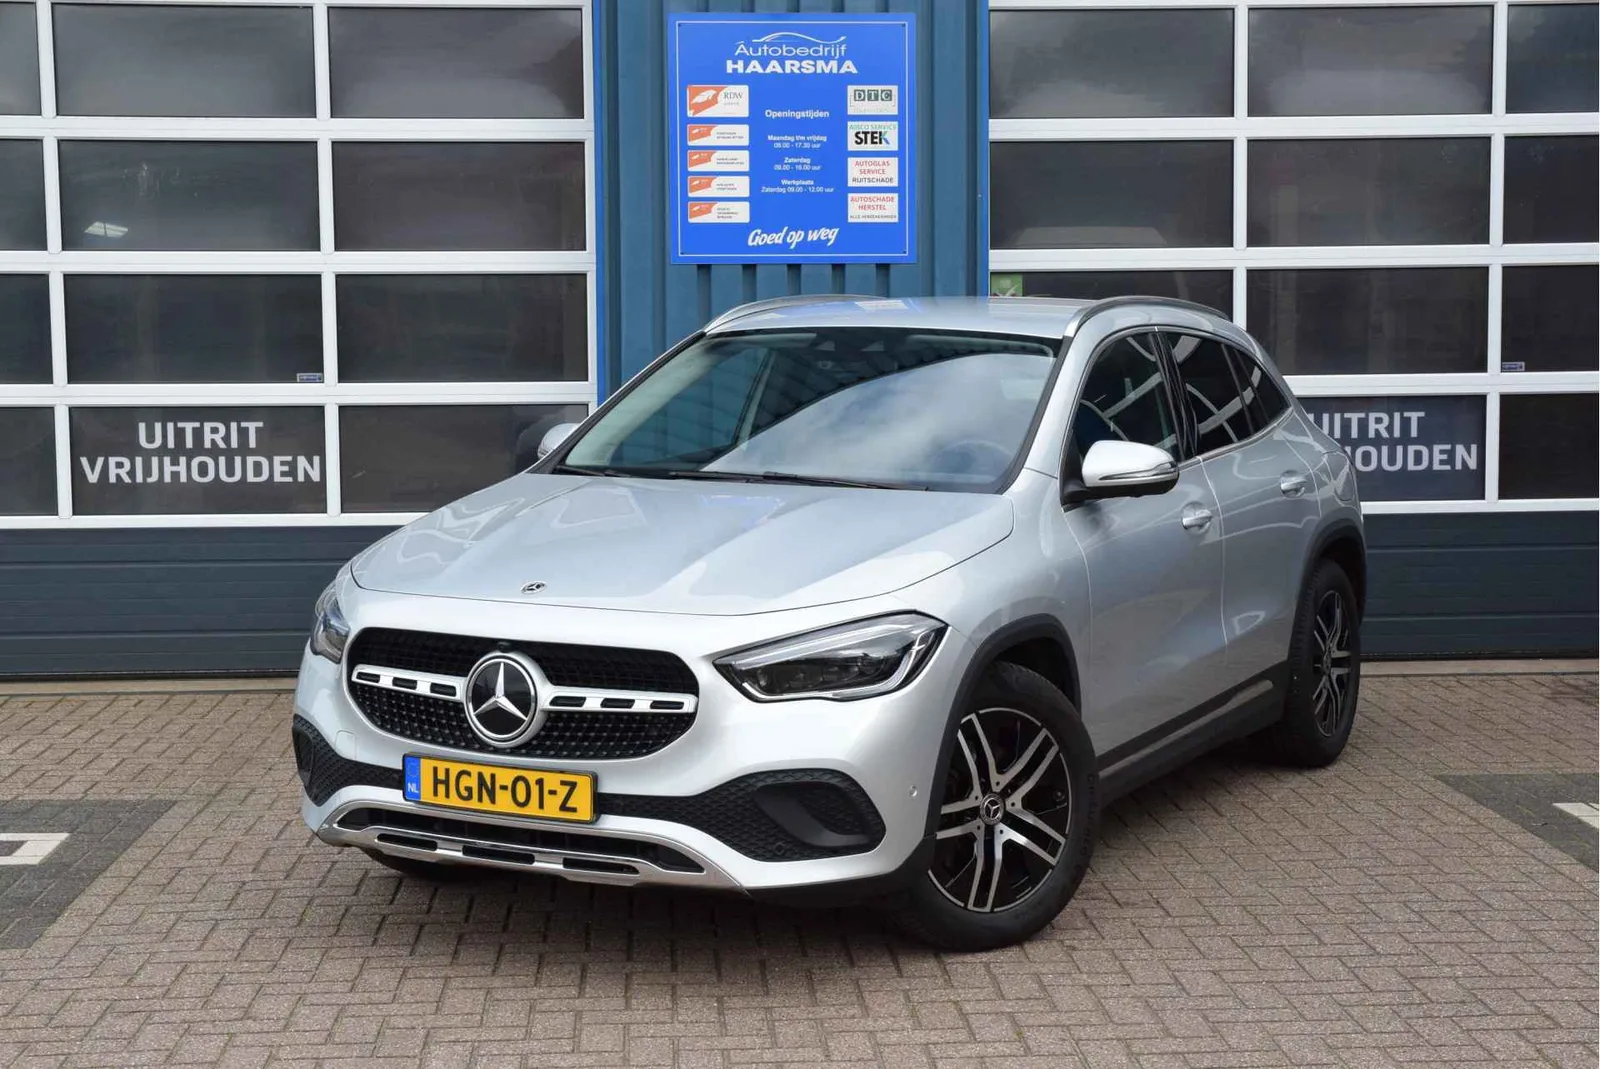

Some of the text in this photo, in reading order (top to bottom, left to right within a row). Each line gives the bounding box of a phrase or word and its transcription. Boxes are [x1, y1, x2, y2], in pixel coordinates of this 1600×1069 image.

[735, 43, 847, 59] Autobedrijf
[726, 60, 858, 74] HAARSMA
[723, 91, 743, 100] RDW
[854, 90, 892, 101] DTC
[765, 109, 829, 119] Openingstijden
[768, 134, 794, 142] Maandag
[807, 134, 827, 142] vrijdag
[854, 131, 890, 145] STEK
[748, 226, 840, 249] Goed op weg
[138, 421, 263, 449] UITRIT
[80, 456, 320, 484] VRIJHOUDEN
[407, 765, 578, 813] NL HGN-01-Z
